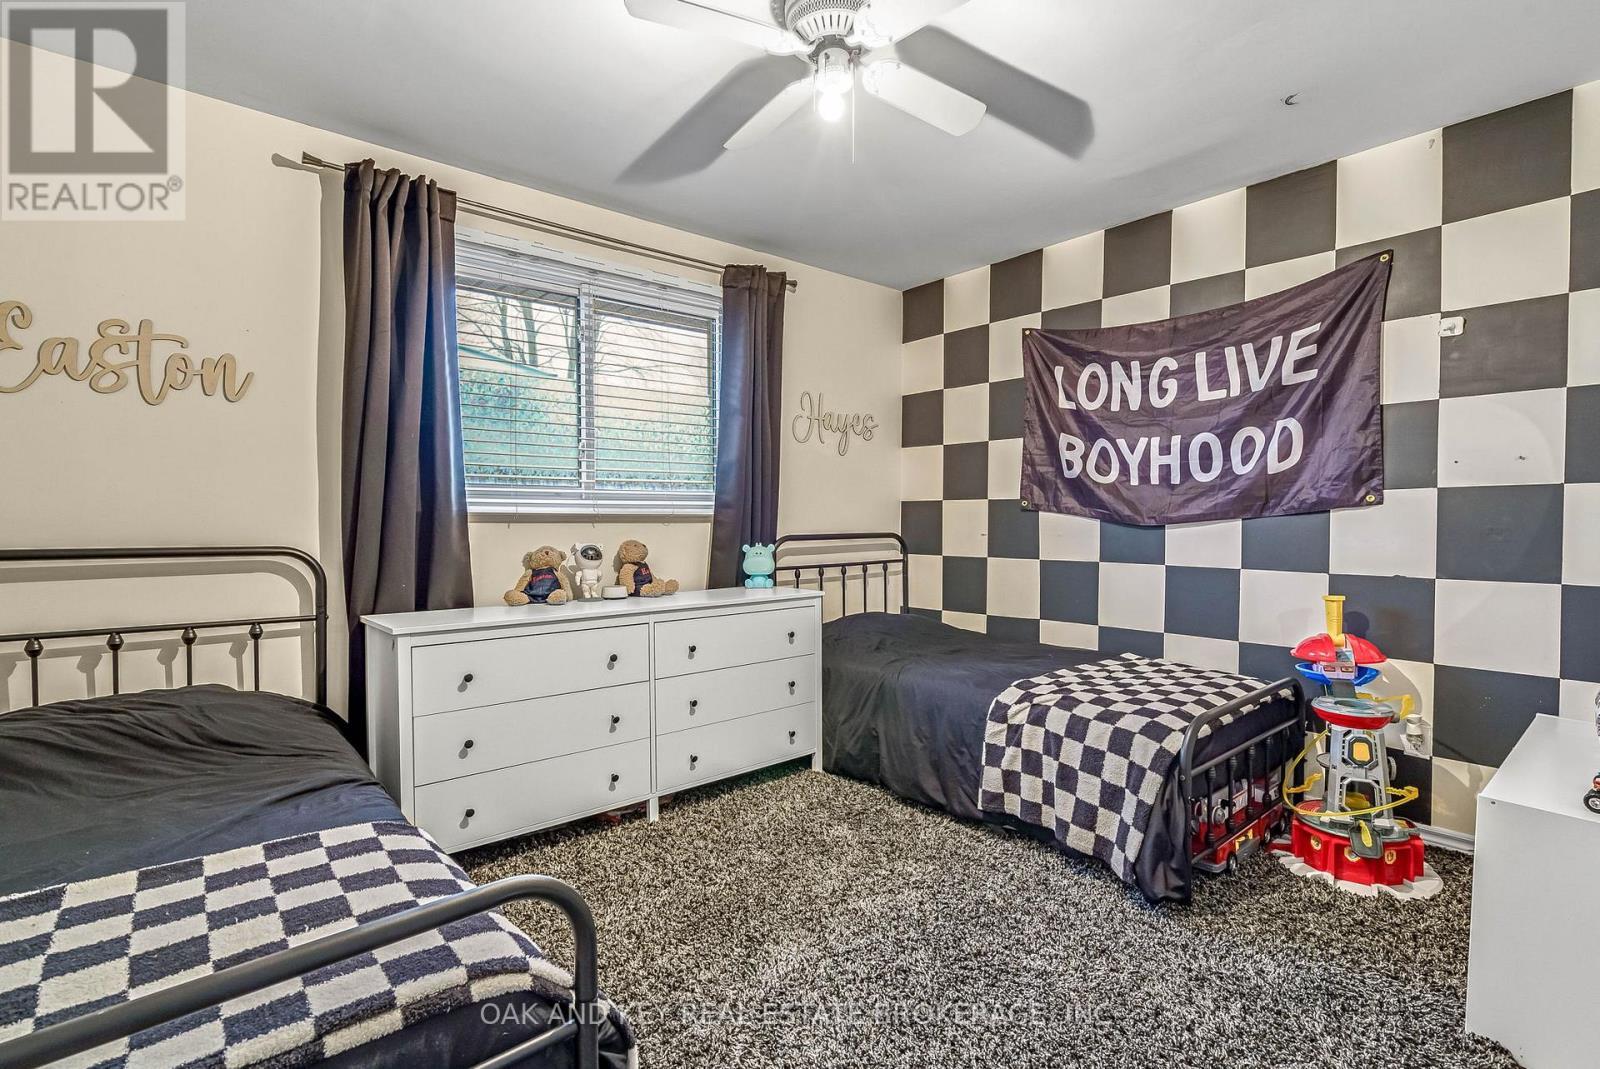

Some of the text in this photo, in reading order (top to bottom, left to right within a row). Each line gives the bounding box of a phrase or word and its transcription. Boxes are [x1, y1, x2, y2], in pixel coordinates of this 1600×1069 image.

[1054, 322, 1322, 412] LONG LIVE
[792, 391, 879, 457] Hayes
[1058, 417, 1304, 486] BOYHOOD
